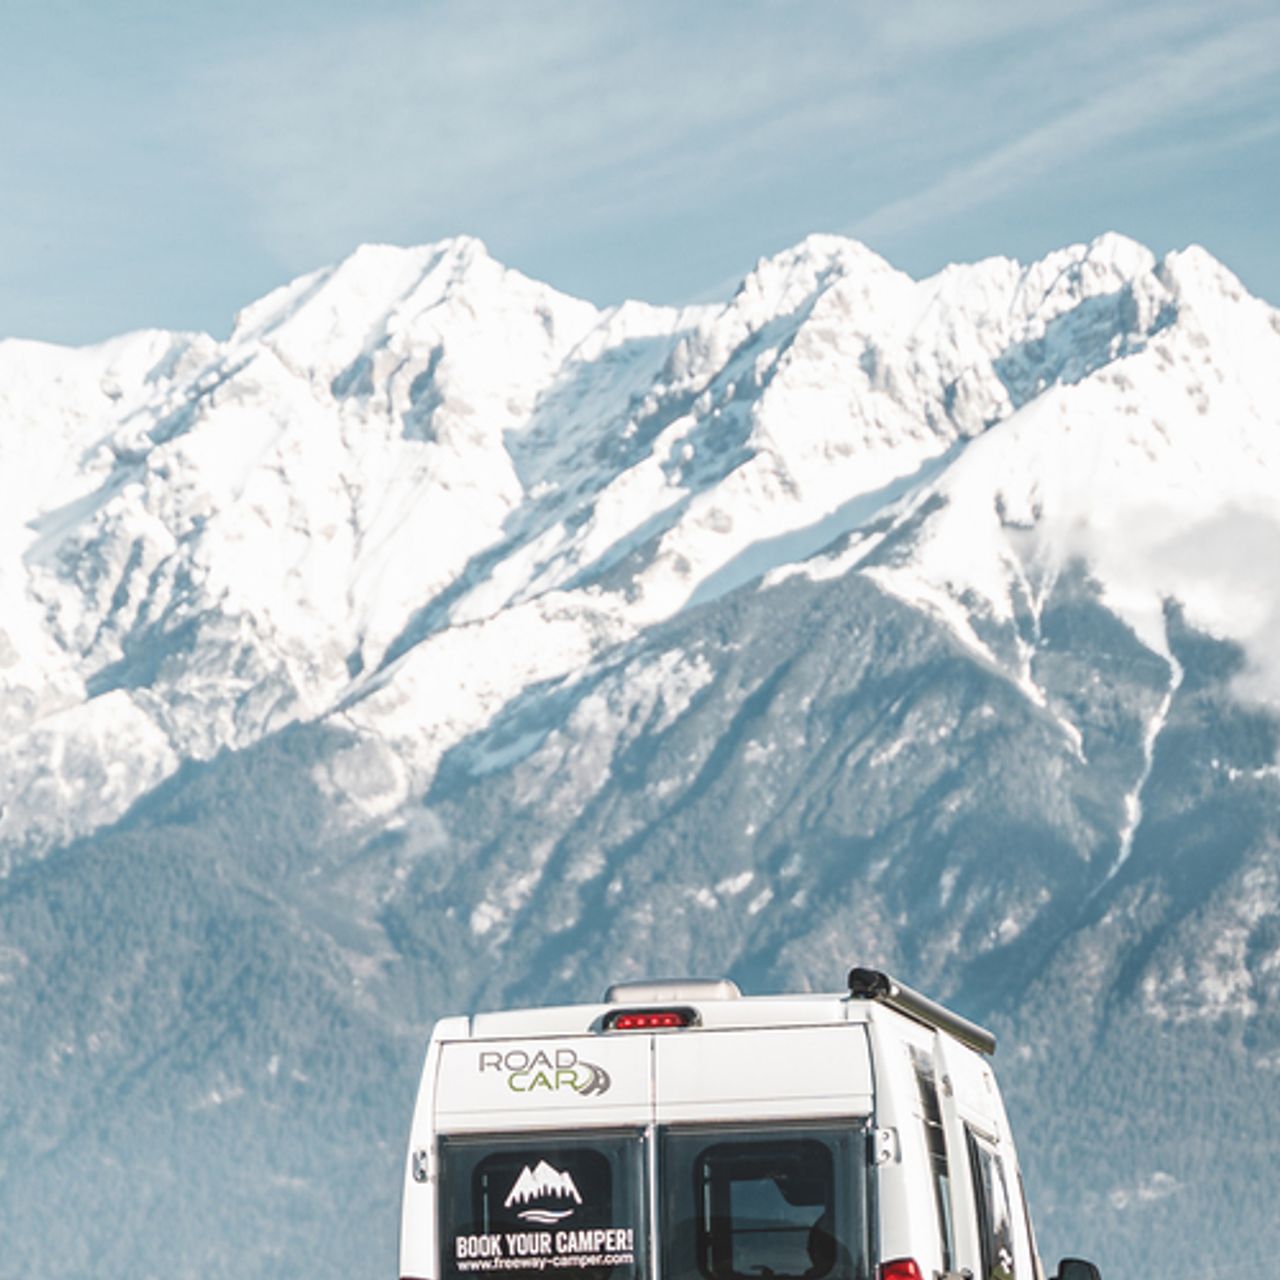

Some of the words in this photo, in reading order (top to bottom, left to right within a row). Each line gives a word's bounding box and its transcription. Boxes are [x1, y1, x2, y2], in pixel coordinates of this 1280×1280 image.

[479, 1049, 577, 1071] ROAD
[508, 1070, 579, 1091] CAR
[456, 1234, 502, 1258] BOOK
[505, 1231, 552, 1256] YOUR
[555, 1229, 634, 1252] CAMPER!
[457, 1253, 634, 1271] www.freeway-camper.com
